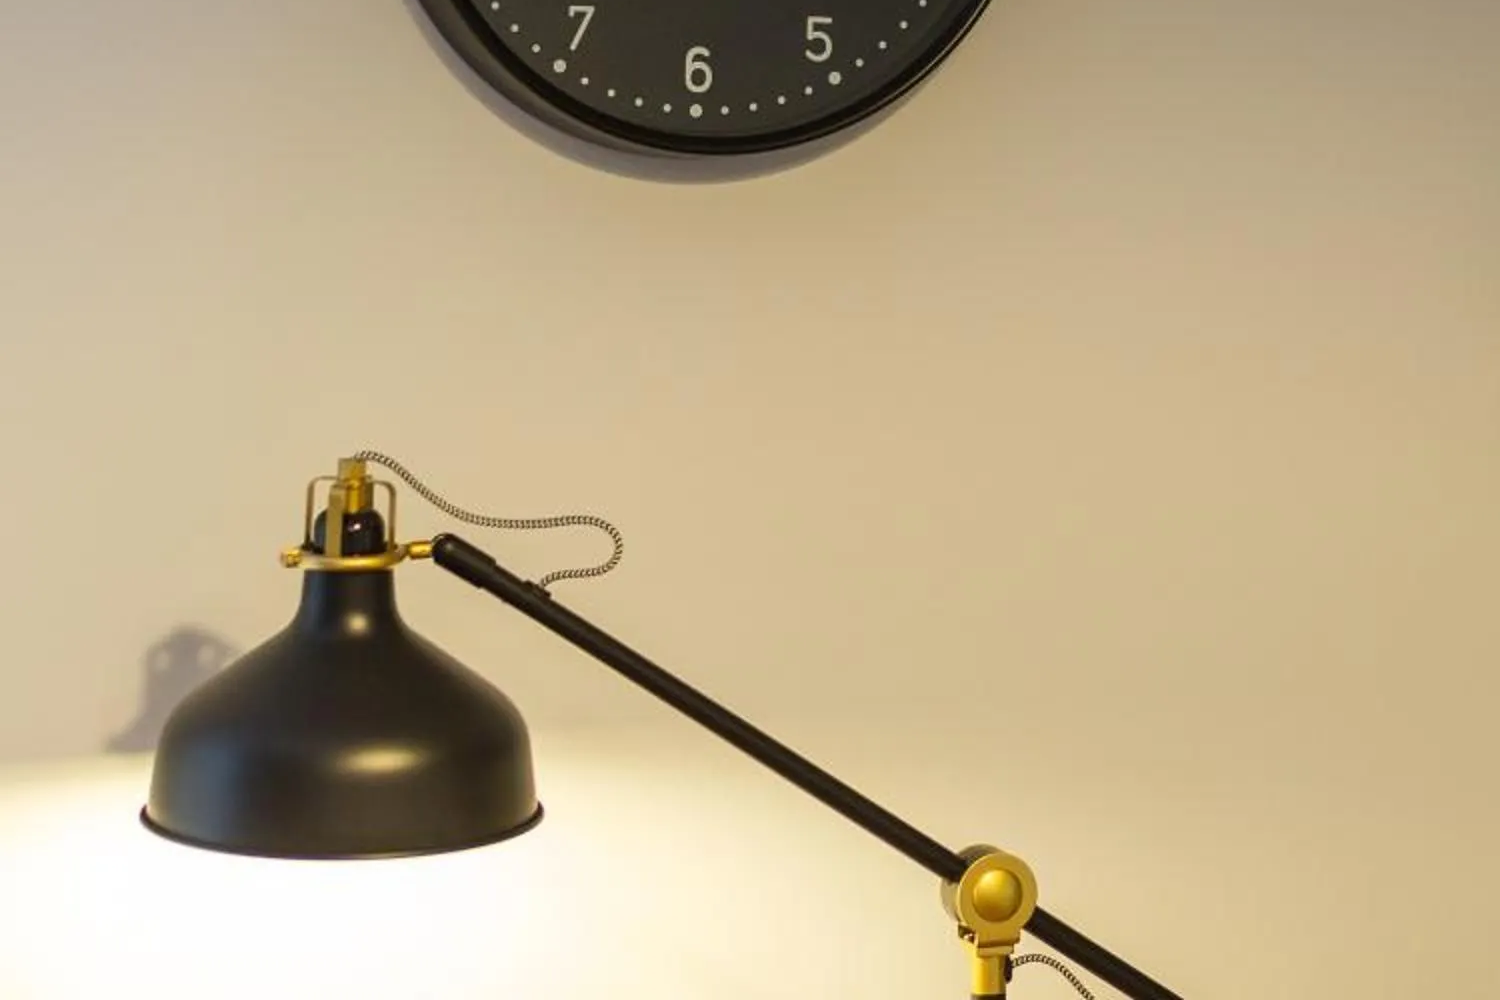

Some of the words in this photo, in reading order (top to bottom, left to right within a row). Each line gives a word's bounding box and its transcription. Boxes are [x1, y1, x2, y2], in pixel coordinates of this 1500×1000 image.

[569, 6, 594, 50] 7
[806, 16, 832, 62] 5
[686, 46, 712, 92] 6
